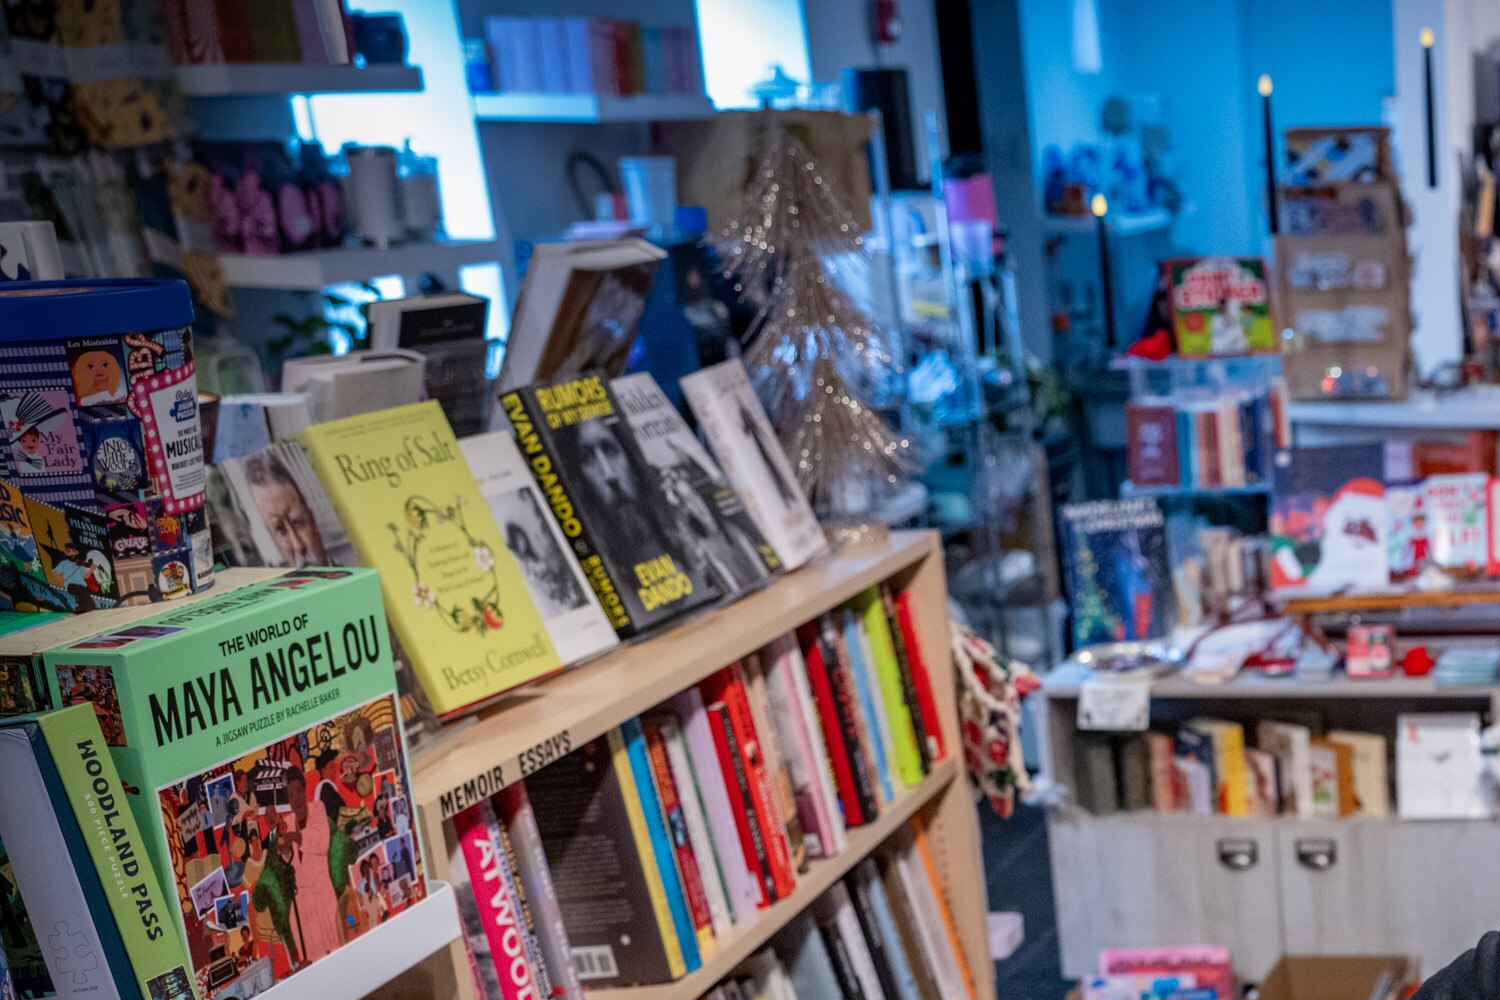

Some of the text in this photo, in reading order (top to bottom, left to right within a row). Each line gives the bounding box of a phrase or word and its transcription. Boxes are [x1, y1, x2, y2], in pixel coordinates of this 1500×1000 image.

[67, 338, 119, 348] Les Misérables
[535, 375, 607, 413] RUMORS
[39, 432, 63, 447] My
[46, 443, 76, 455] Fair
[334, 431, 456, 488] Ring of Salt
[43, 455, 78, 468] Lady
[502, 392, 543, 453] EVAN
[533, 453, 583, 539] DANDO
[70, 518, 107, 536] PHANTOM
[79, 534, 104, 549] OPERA
[113, 536, 149, 552] GREASE
[633, 553, 678, 582] EVAN
[637, 571, 694, 612] DANDO
[218, 613, 309, 657] THE WORLD OF
[148, 614, 381, 748] MAYA ANGELOU
[440, 632, 549, 692] Betsy Cornwell
[215, 687, 341, 748] A JIGSAW PUZZLE BY RACHELLE BAKER
[439, 730, 573, 822] MEMOIR ESSAYS
[76, 738, 164, 943] WOODLAND PASS
[84, 792, 129, 901] 500 PIECE PUZZLE
